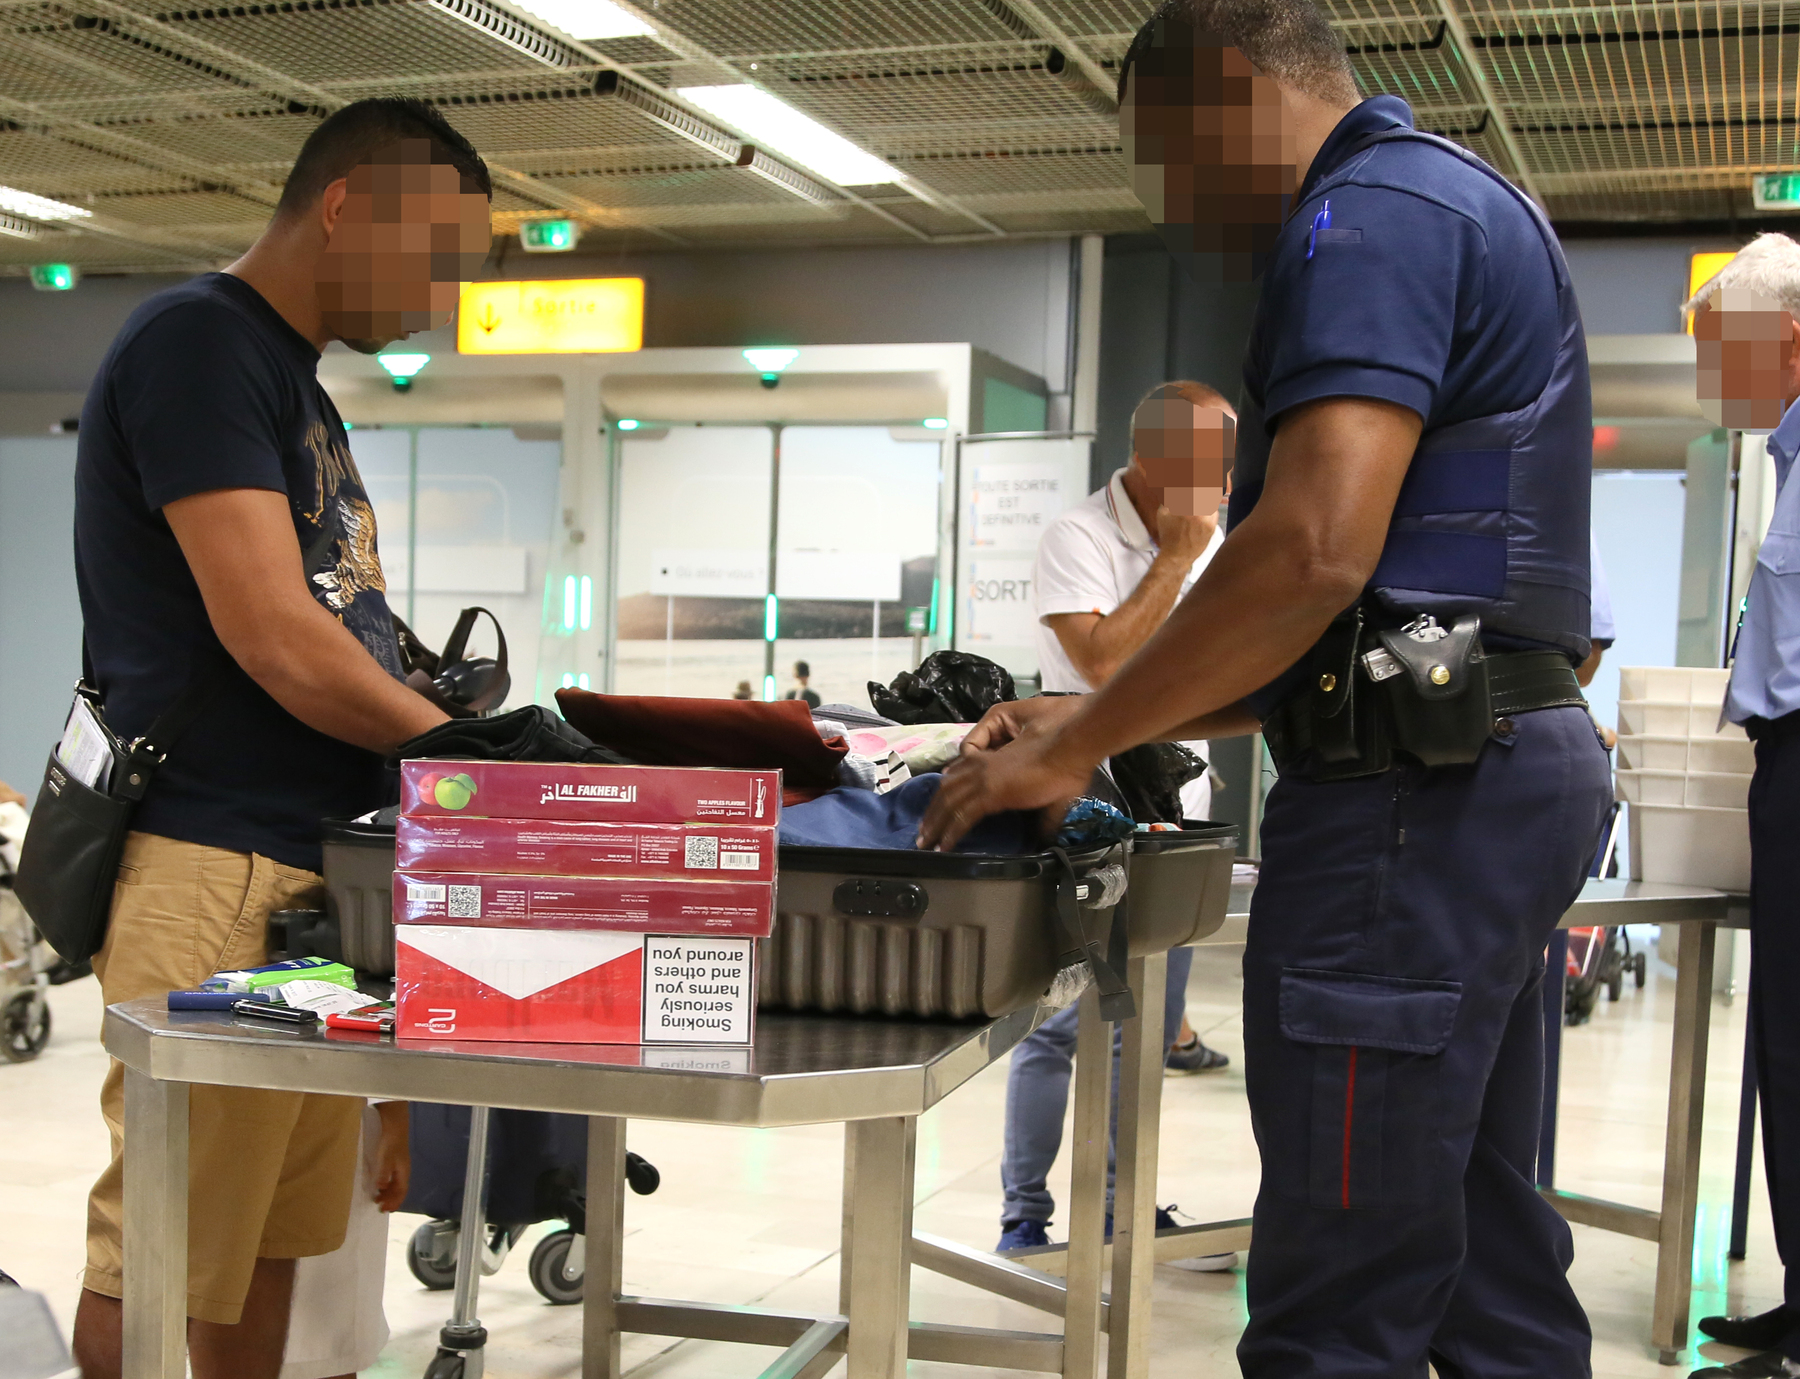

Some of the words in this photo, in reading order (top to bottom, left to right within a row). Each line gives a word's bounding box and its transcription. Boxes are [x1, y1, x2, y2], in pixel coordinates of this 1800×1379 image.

[533, 297, 596, 315] Sortie
[1014, 478, 1059, 492] SORTIE
[998, 496, 1020, 508] EST
[974, 580, 1032, 601] SORT
[560, 784, 575, 796] AL
[577, 785, 619, 797] FAKHER
[652, 947, 682, 959] you
[686, 950, 743, 963] around
[654, 966, 706, 980] others
[711, 968, 741, 980] and
[655, 981, 684, 993] you
[689, 984, 739, 998] harms
[660, 998, 733, 1014] seriously
[428, 1008, 456, 1034] 2
[661, 1015, 732, 1031] Smoking
